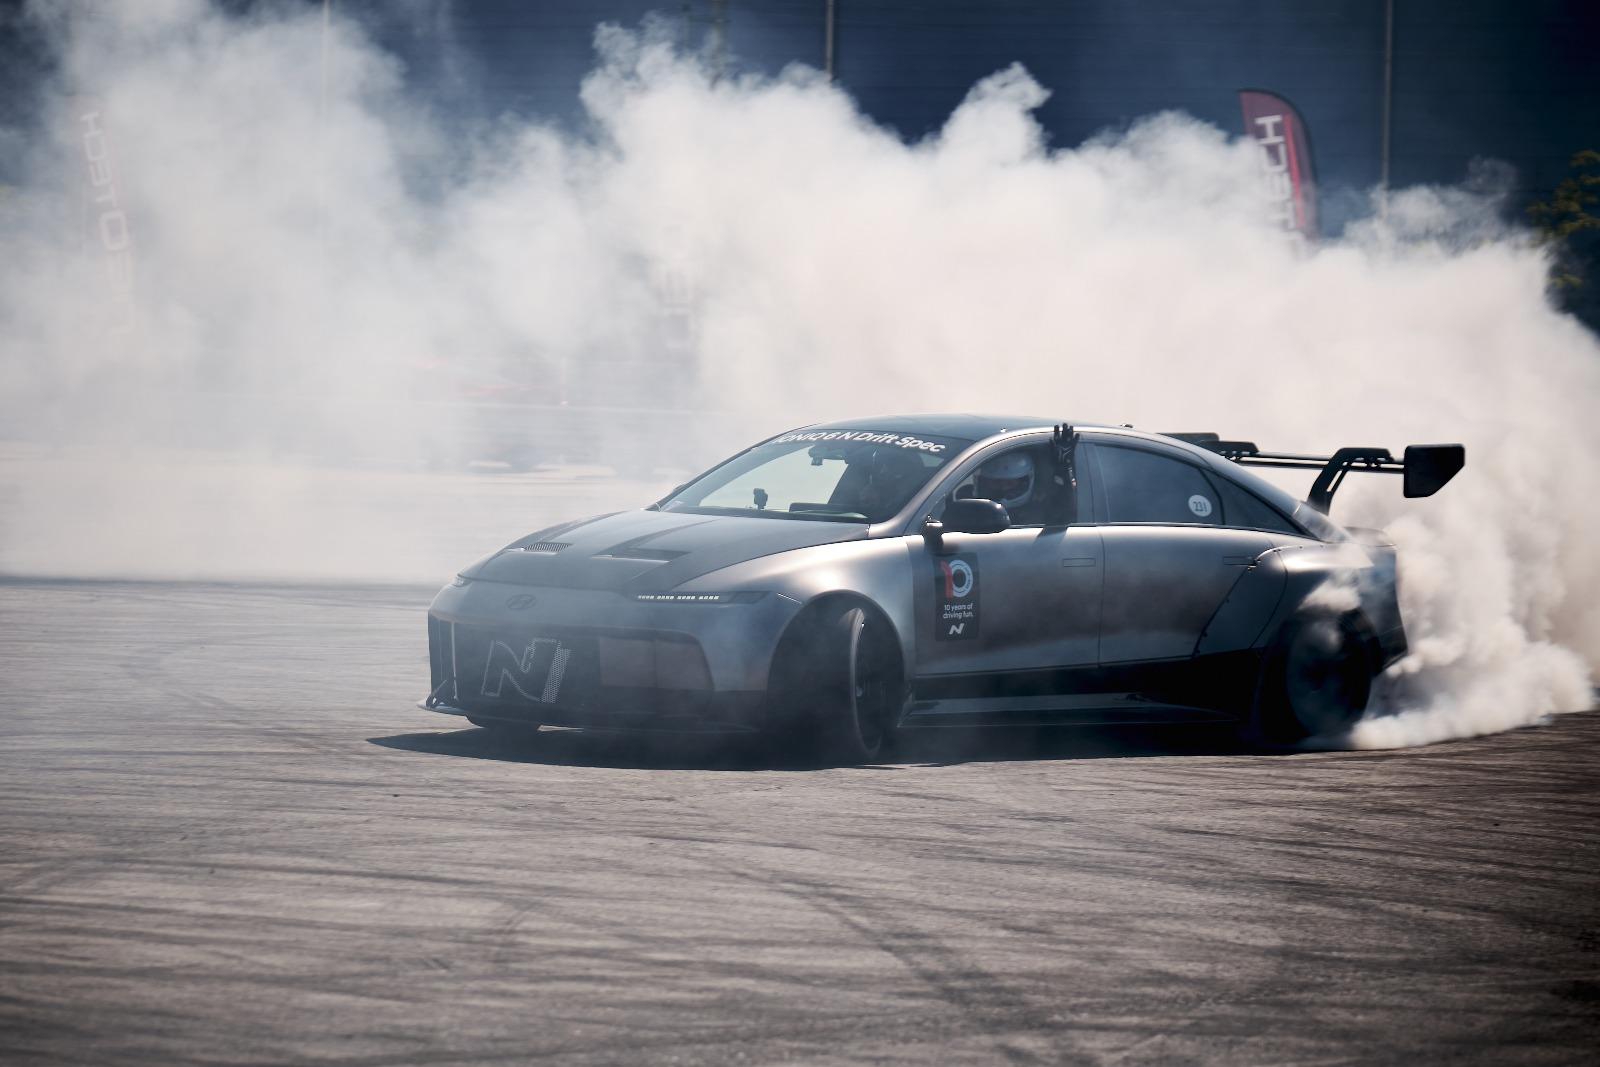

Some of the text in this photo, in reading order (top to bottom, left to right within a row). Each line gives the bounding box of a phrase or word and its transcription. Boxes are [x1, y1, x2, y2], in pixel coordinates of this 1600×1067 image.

[852, 432, 899, 445] Drift
[895, 436, 946, 453] Spec
[943, 611, 962, 619] driving
[949, 623, 964, 634] N
